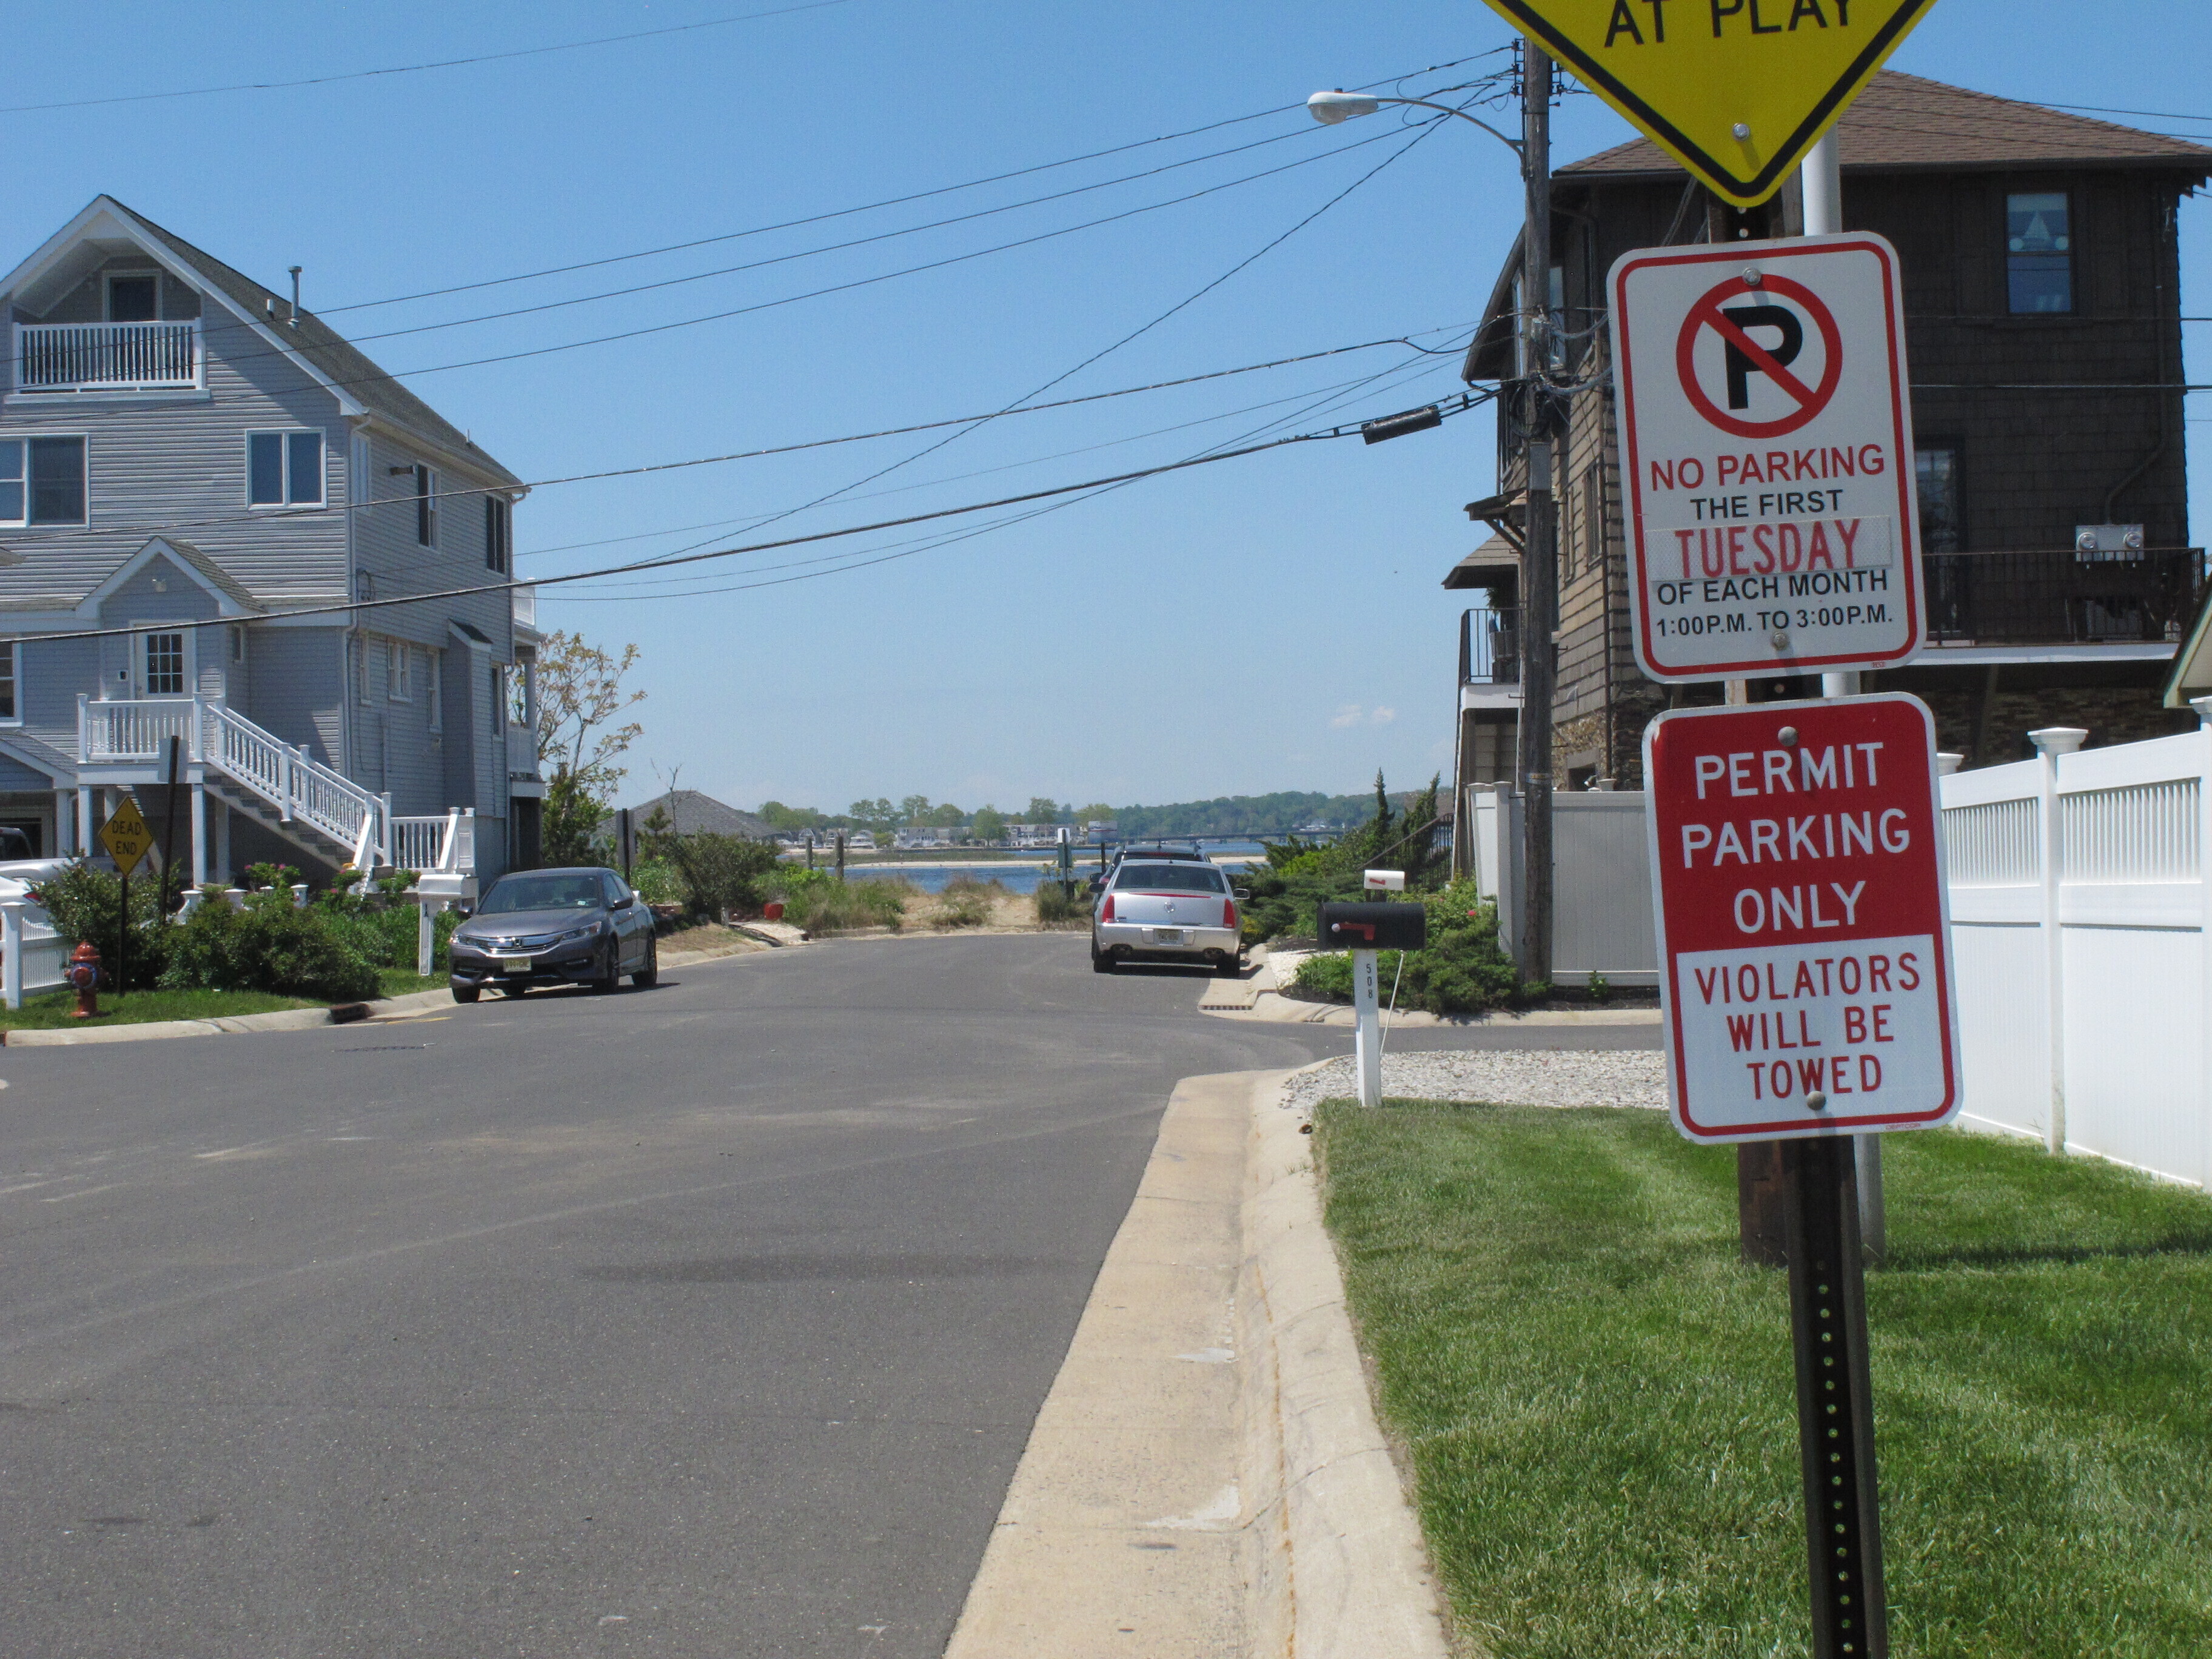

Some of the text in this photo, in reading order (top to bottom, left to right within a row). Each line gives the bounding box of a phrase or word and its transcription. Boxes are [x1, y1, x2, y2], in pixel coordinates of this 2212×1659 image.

[1604, 0, 1671, 47] AT
[1651, 444, 1885, 491] NO PARKING
[1690, 489, 1843, 520] THE FIRST
[1675, 518, 1862, 578] TUESDAY
[1657, 569, 1888, 606] OF EACH MONTH
[1657, 604, 1893, 637] 1:00P.M. TO 3:00P.M.
[1695, 742, 1883, 800] PERMIT
[112, 820, 141, 834] DEAD
[116, 841, 136, 855] END
[1681, 808, 1910, 869] PARKING
[1733, 880, 1866, 934] ONLY
[1694, 953, 1920, 1005] VIOLATORS
[1726, 1005, 1894, 1053] WILL BE
[1746, 1054, 1882, 1101] TOWED
